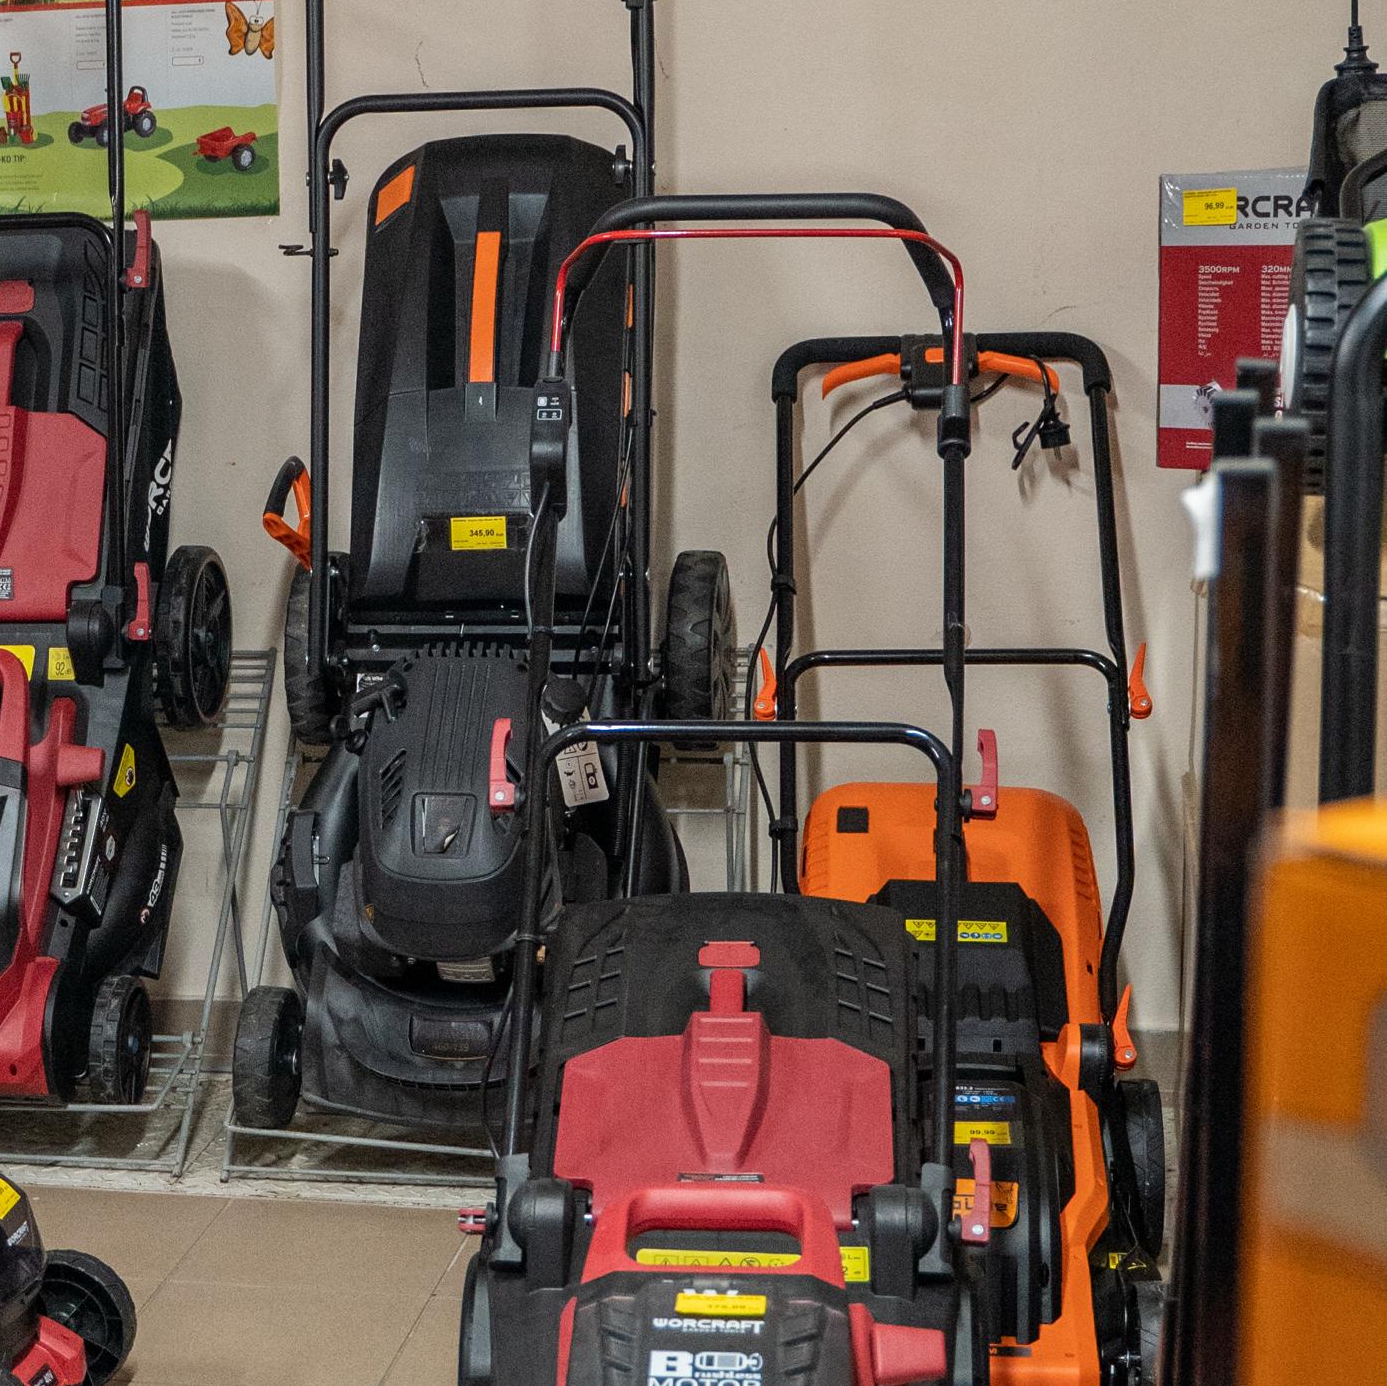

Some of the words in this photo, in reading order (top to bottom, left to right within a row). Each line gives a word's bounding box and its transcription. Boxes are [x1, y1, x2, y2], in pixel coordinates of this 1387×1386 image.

[1236, 195, 1314, 218] RCRA
[1198, 265, 1240, 273] 3500RPM
[55, 662, 65, 676] 92
[652, 1317, 765, 1334] WORCRAFT
